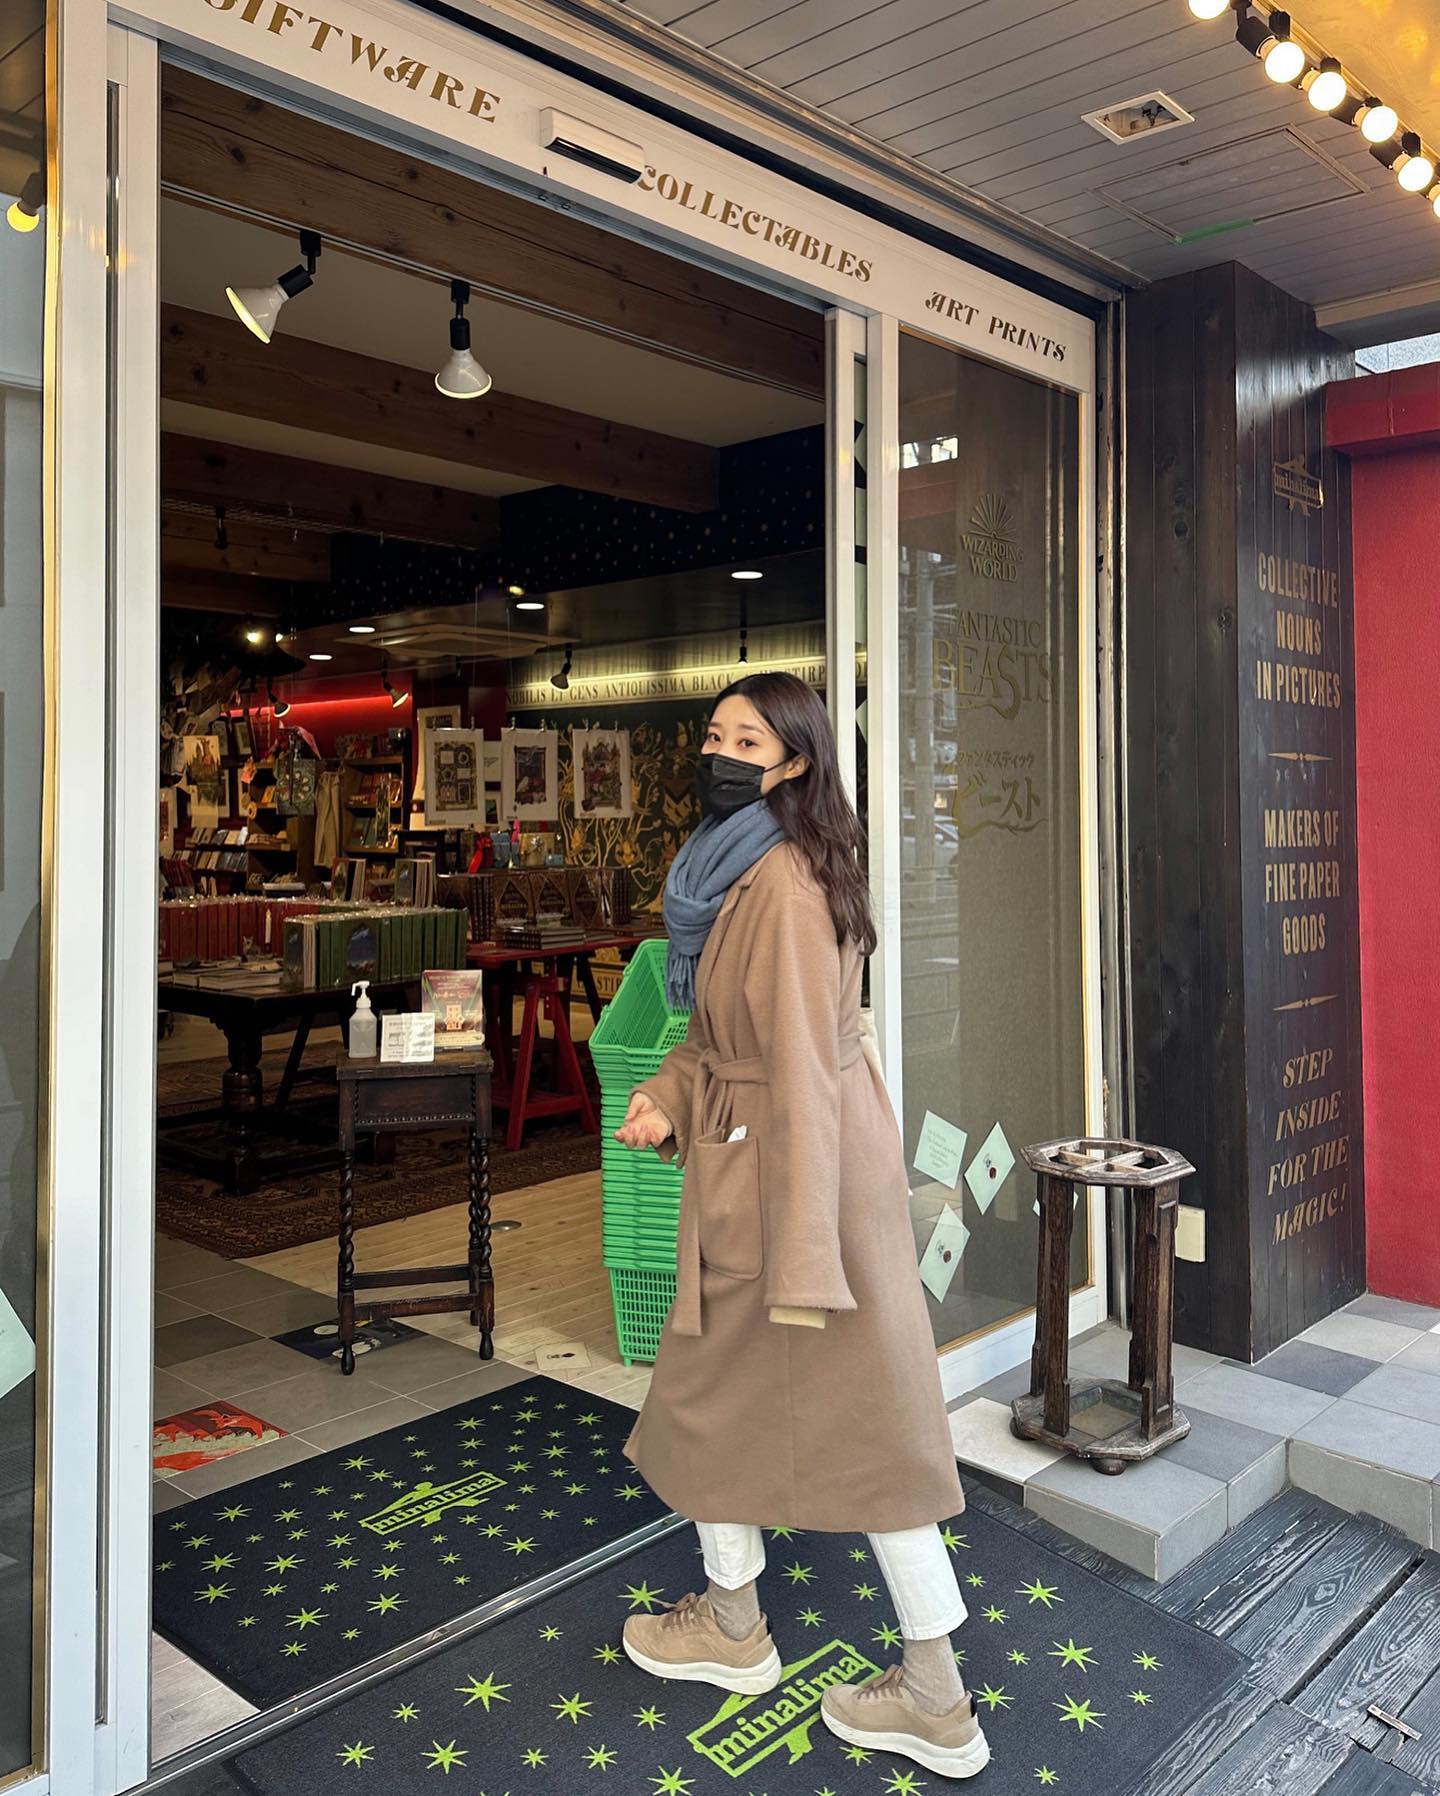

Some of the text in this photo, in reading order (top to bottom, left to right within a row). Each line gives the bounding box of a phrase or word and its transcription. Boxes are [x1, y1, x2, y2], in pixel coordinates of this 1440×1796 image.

[637, 165, 873, 282] COLLECTABLES
[924, 291, 1066, 362] ART PRINTS
[960, 533, 1024, 561] WIZARDING
[969, 554, 1018, 582] WORLD
[1257, 551, 1338, 608] COLLECTIVE
[1276, 611, 1322, 655] NOUNS
[570, 685, 599, 701] GENS
[931, 637, 1058, 718] BEASTS
[1256, 660, 1341, 709] IN PICTURES
[1264, 809, 1340, 848] MAKERS OF
[1265, 861, 1340, 903] FINE PAPER
[1282, 912, 1326, 956] GOODS
[1282, 1048, 1334, 1089] STEP
[1274, 1090, 1342, 1142] INSIDE
[1267, 1135, 1349, 1196] FOR THE
[1272, 1183, 1349, 1246] MAGIC!
[372, 1476, 497, 1531] minalima
[709, 1655, 869, 1764] minalima
